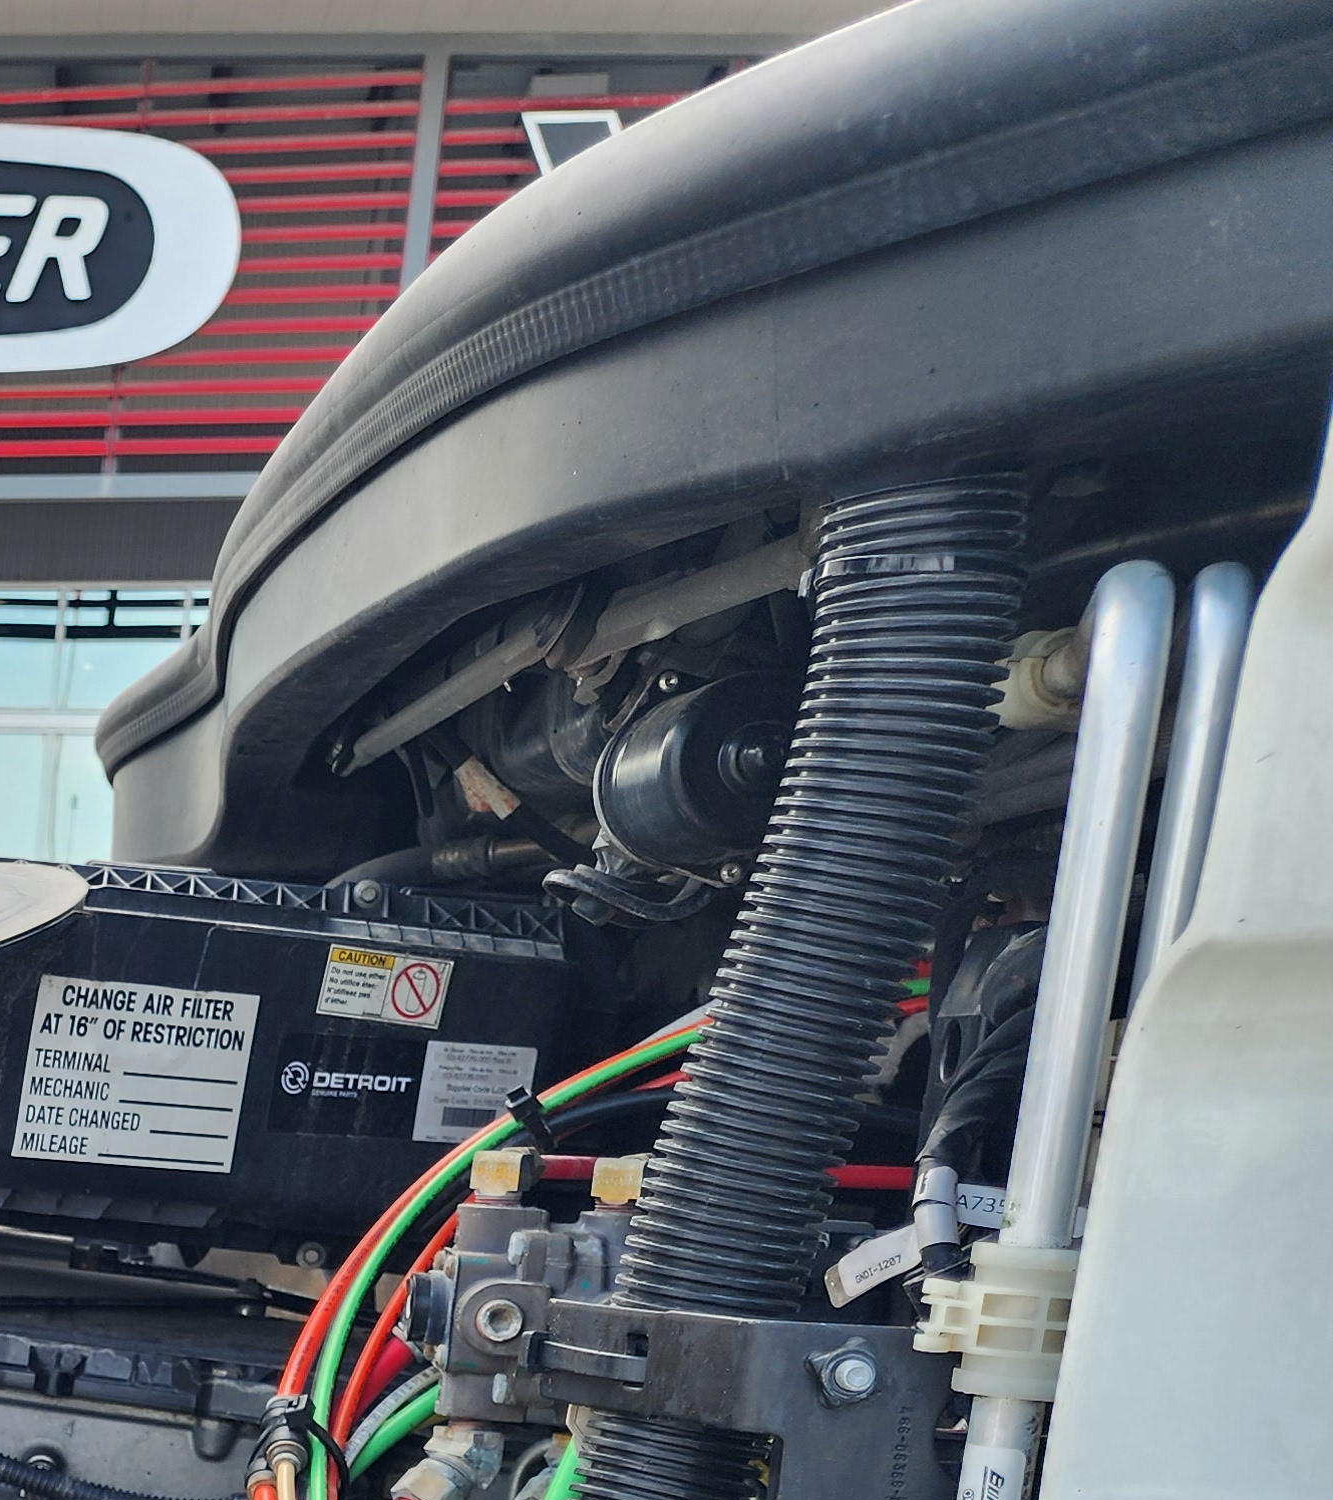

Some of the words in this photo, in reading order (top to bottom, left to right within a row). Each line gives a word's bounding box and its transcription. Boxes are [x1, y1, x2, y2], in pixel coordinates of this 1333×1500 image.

[338, 950, 387, 967] CAUTION
[61, 984, 137, 1012] CHANGE
[142, 992, 174, 1017] AIR
[180, 997, 235, 1022] FILTER
[39, 1012, 64, 1035] AT
[69, 1014, 98, 1038] 16"
[102, 1018, 126, 1042] OF
[130, 1021, 245, 1052] RESTRICTION
[34, 1047, 111, 1074] TERMINAL
[29, 1076, 110, 1101] MECHANIC
[311, 1071, 413, 1094] DETROIT
[25, 1104, 65, 1126] DATE
[68, 1109, 141, 1132] CHANGED
[20, 1132, 89, 1156] MILEAGE
